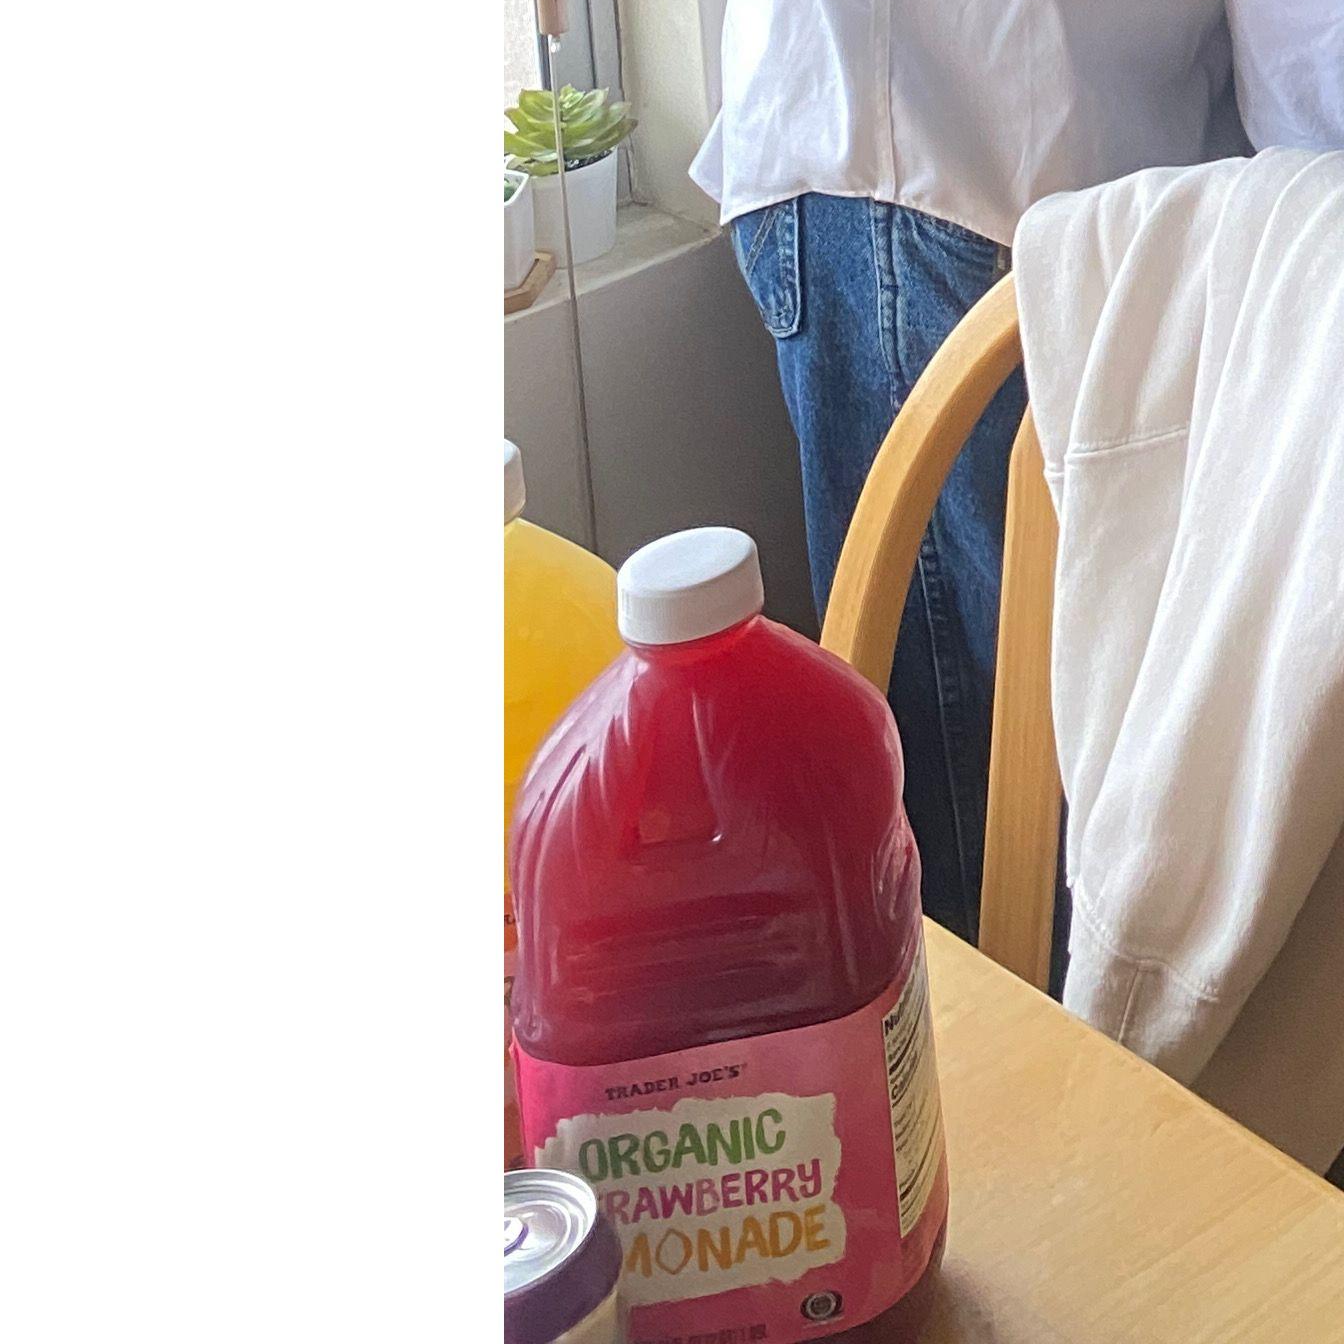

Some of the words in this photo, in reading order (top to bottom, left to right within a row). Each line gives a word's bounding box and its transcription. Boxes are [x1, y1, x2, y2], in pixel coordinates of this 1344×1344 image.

[605, 1076, 680, 1101] TRADER
[686, 1064, 742, 1086] JOE'S
[577, 1108, 787, 1184] ORGANIC
[600, 1158, 823, 1226] RAWBERRY
[625, 1203, 831, 1278] MONADE
